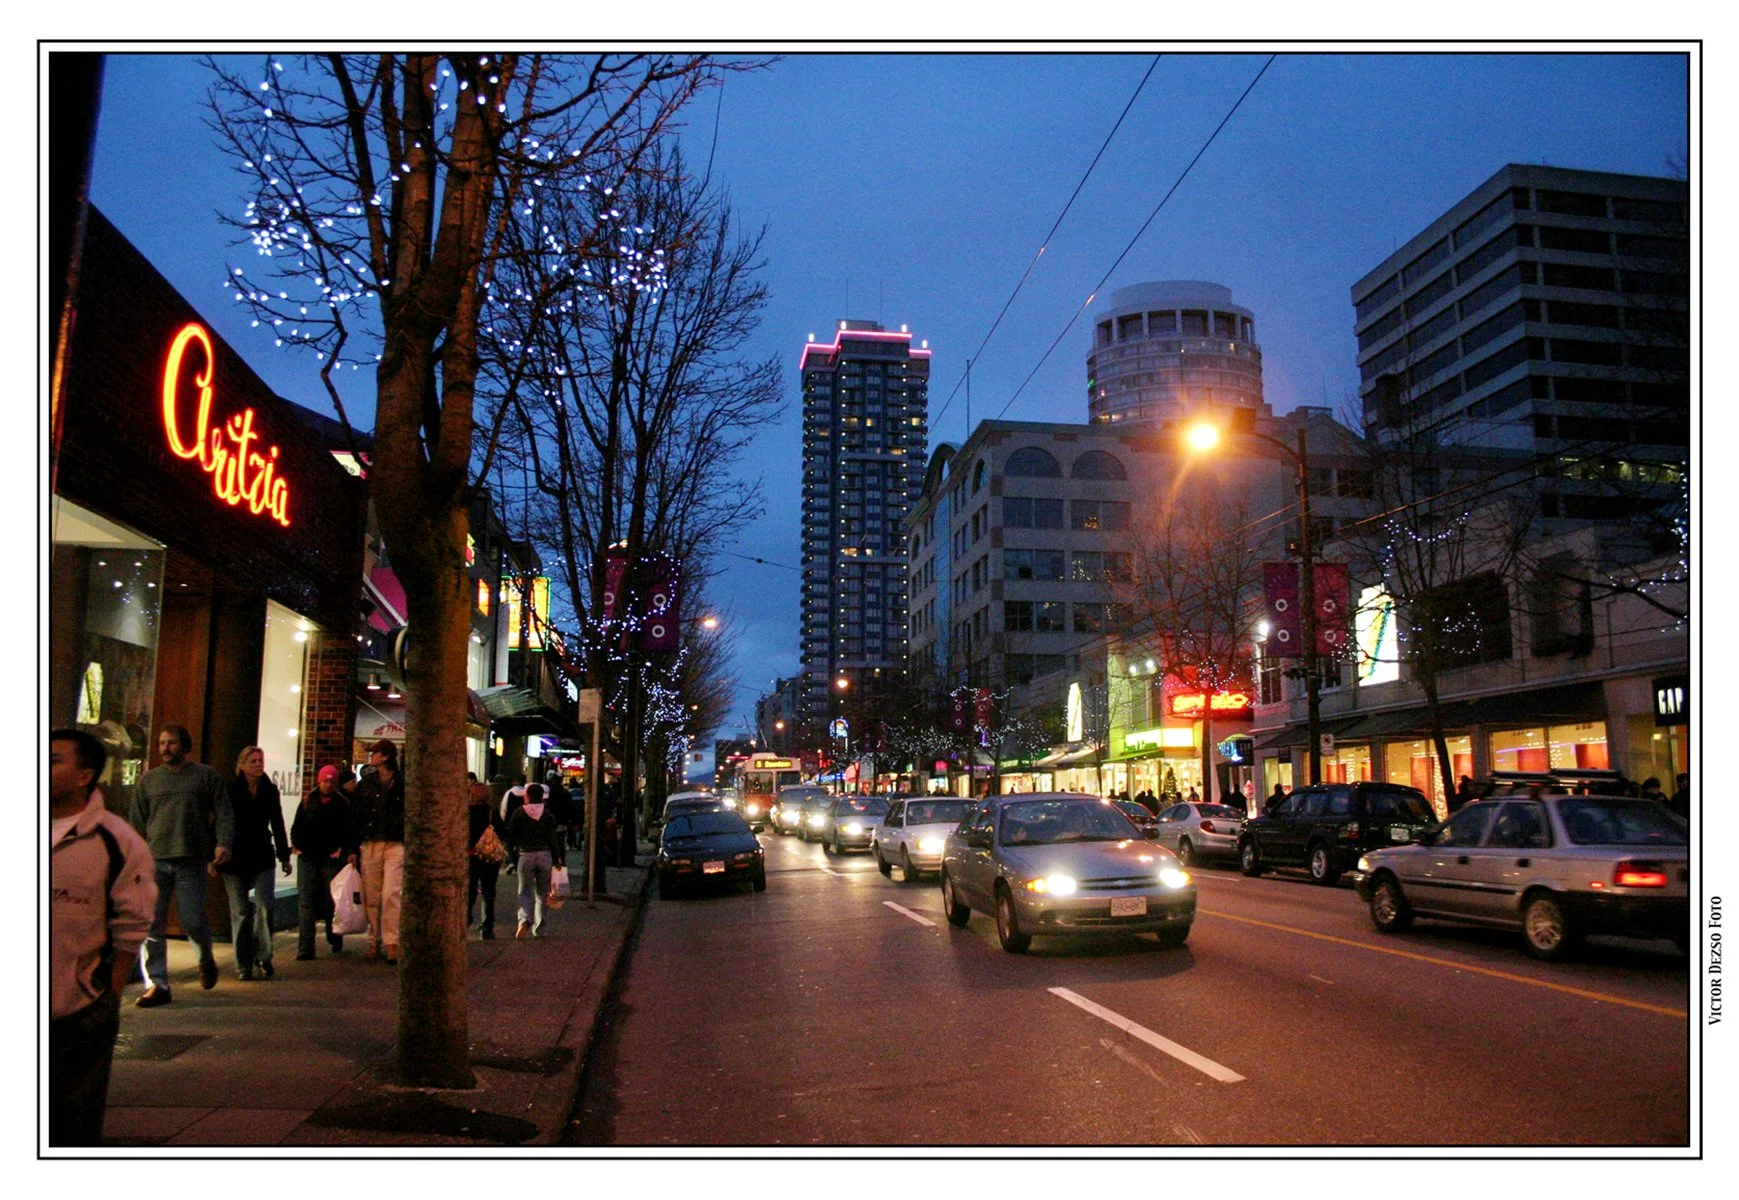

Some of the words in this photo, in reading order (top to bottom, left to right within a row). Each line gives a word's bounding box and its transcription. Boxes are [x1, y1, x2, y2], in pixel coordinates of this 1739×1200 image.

[162, 322, 290, 527] Aritzia
[1657, 687, 1684, 715] GAP
[272, 770, 301, 797] SALE
